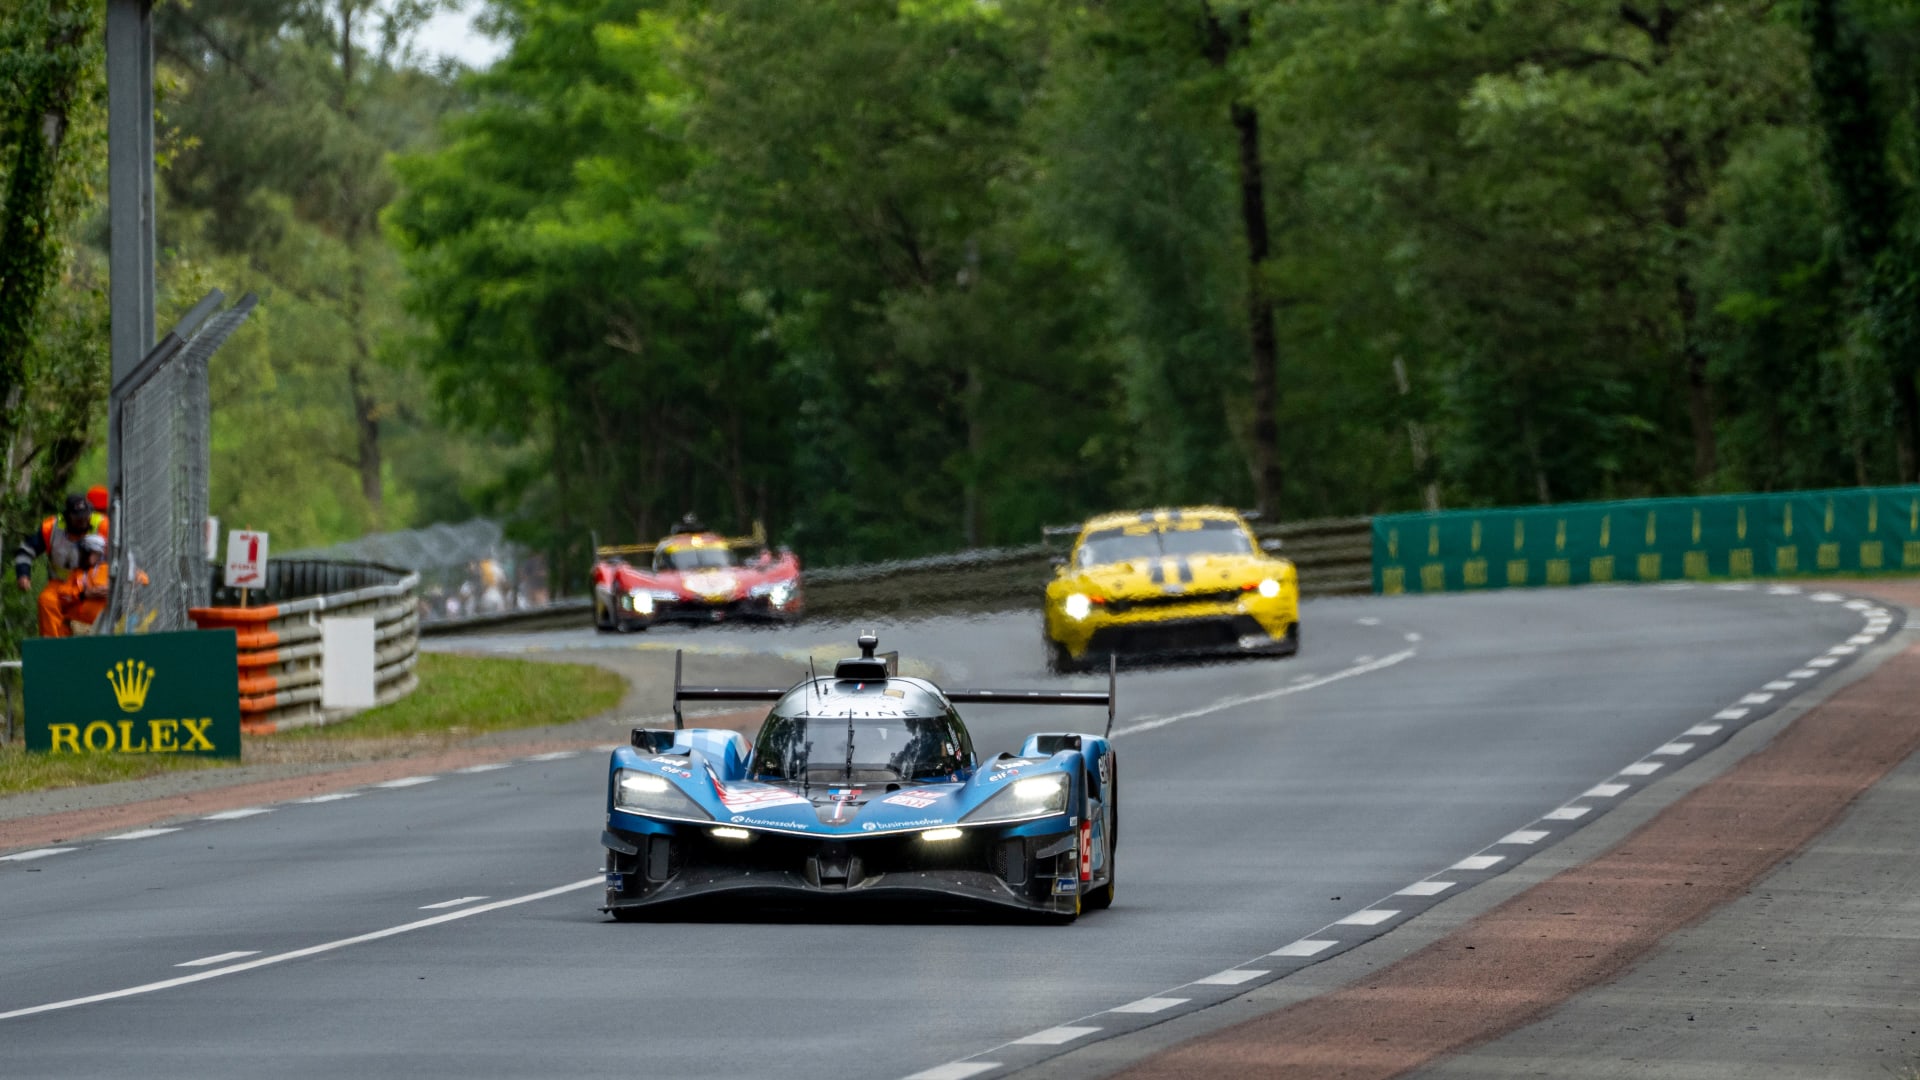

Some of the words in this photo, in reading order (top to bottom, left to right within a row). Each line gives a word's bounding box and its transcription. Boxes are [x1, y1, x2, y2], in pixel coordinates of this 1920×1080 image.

[794, 709, 920, 718] ALPINE
[48, 718, 216, 754] ROLEX
[745, 817, 808, 830] businessolver
[877, 819, 944, 830] businessolver
